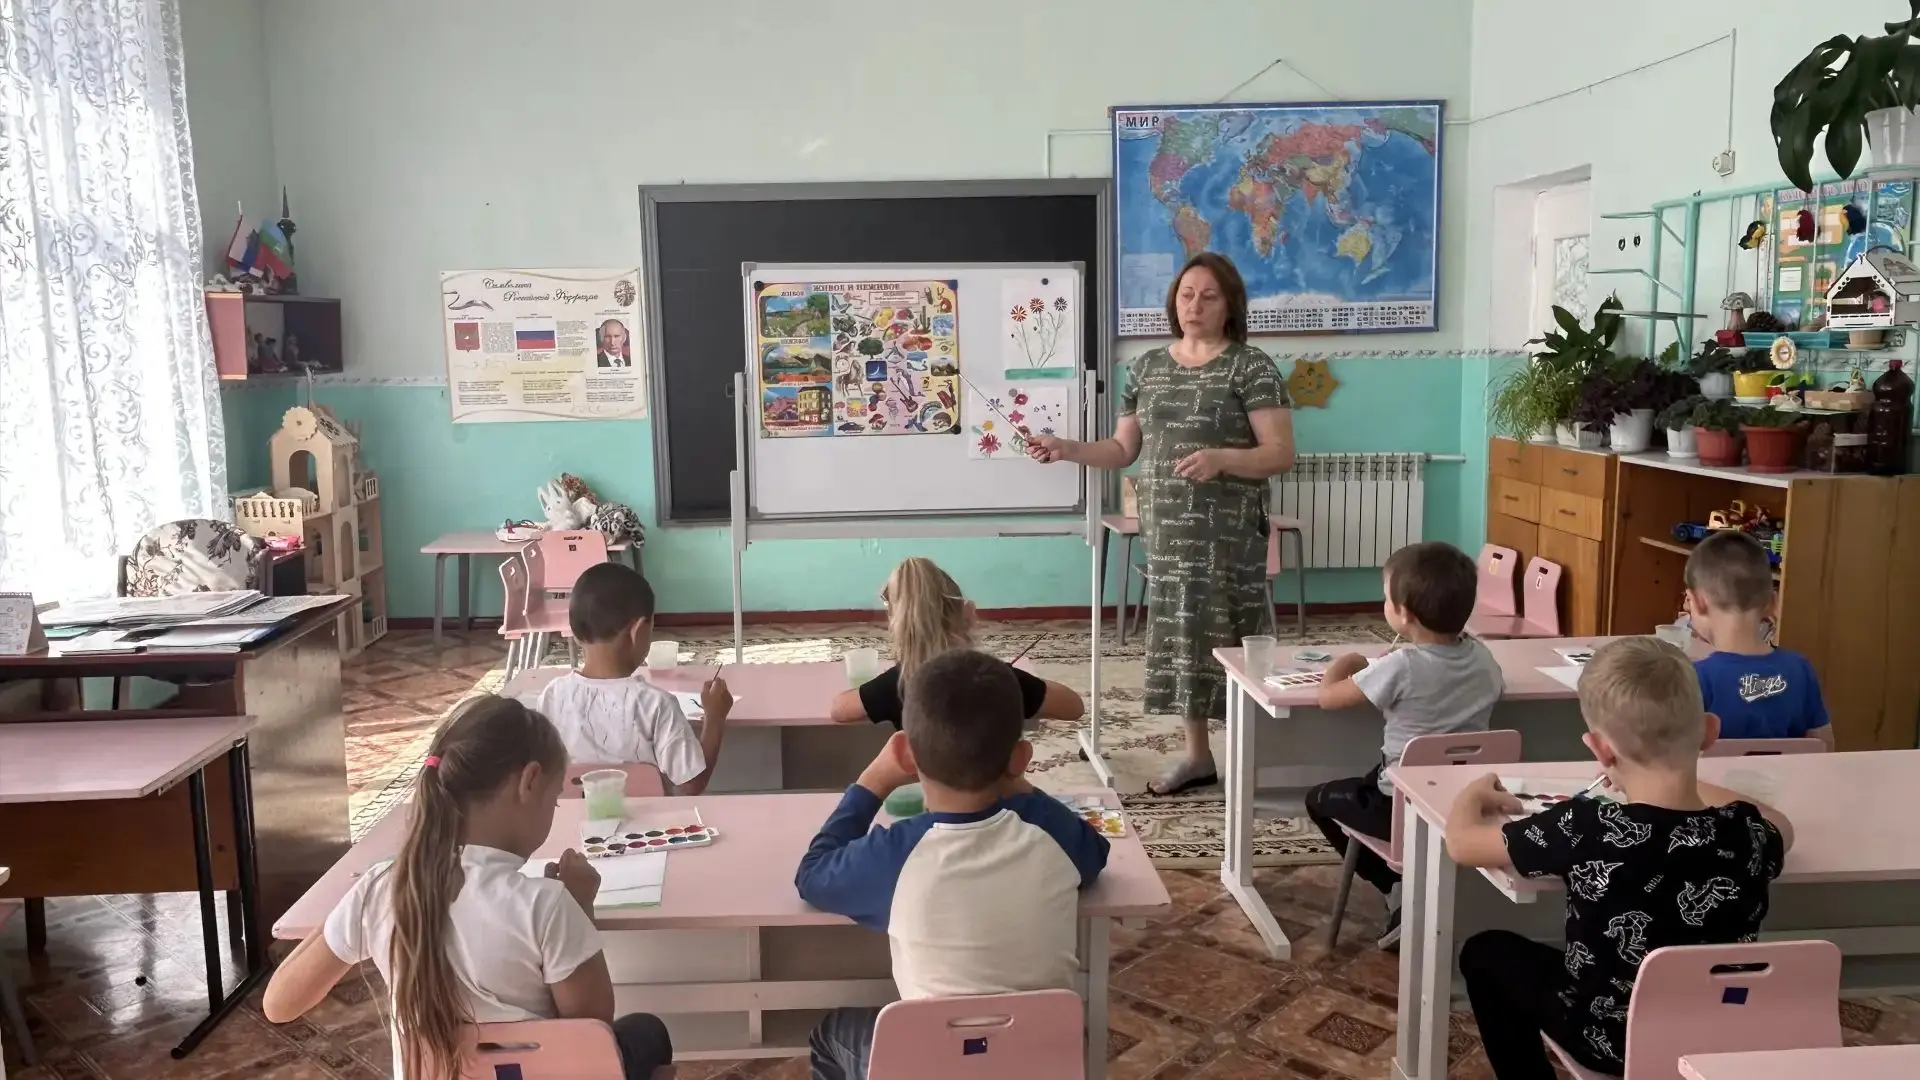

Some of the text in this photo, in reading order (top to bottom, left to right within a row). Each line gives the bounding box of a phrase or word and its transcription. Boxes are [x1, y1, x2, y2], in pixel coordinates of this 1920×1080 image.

[1125, 115, 1160, 128] МИР
[813, 284, 846, 292] ЖИВОЕ
[856, 283, 900, 291] НЕЖИВОЕ
[1643, 874, 1665, 893] CHILL
